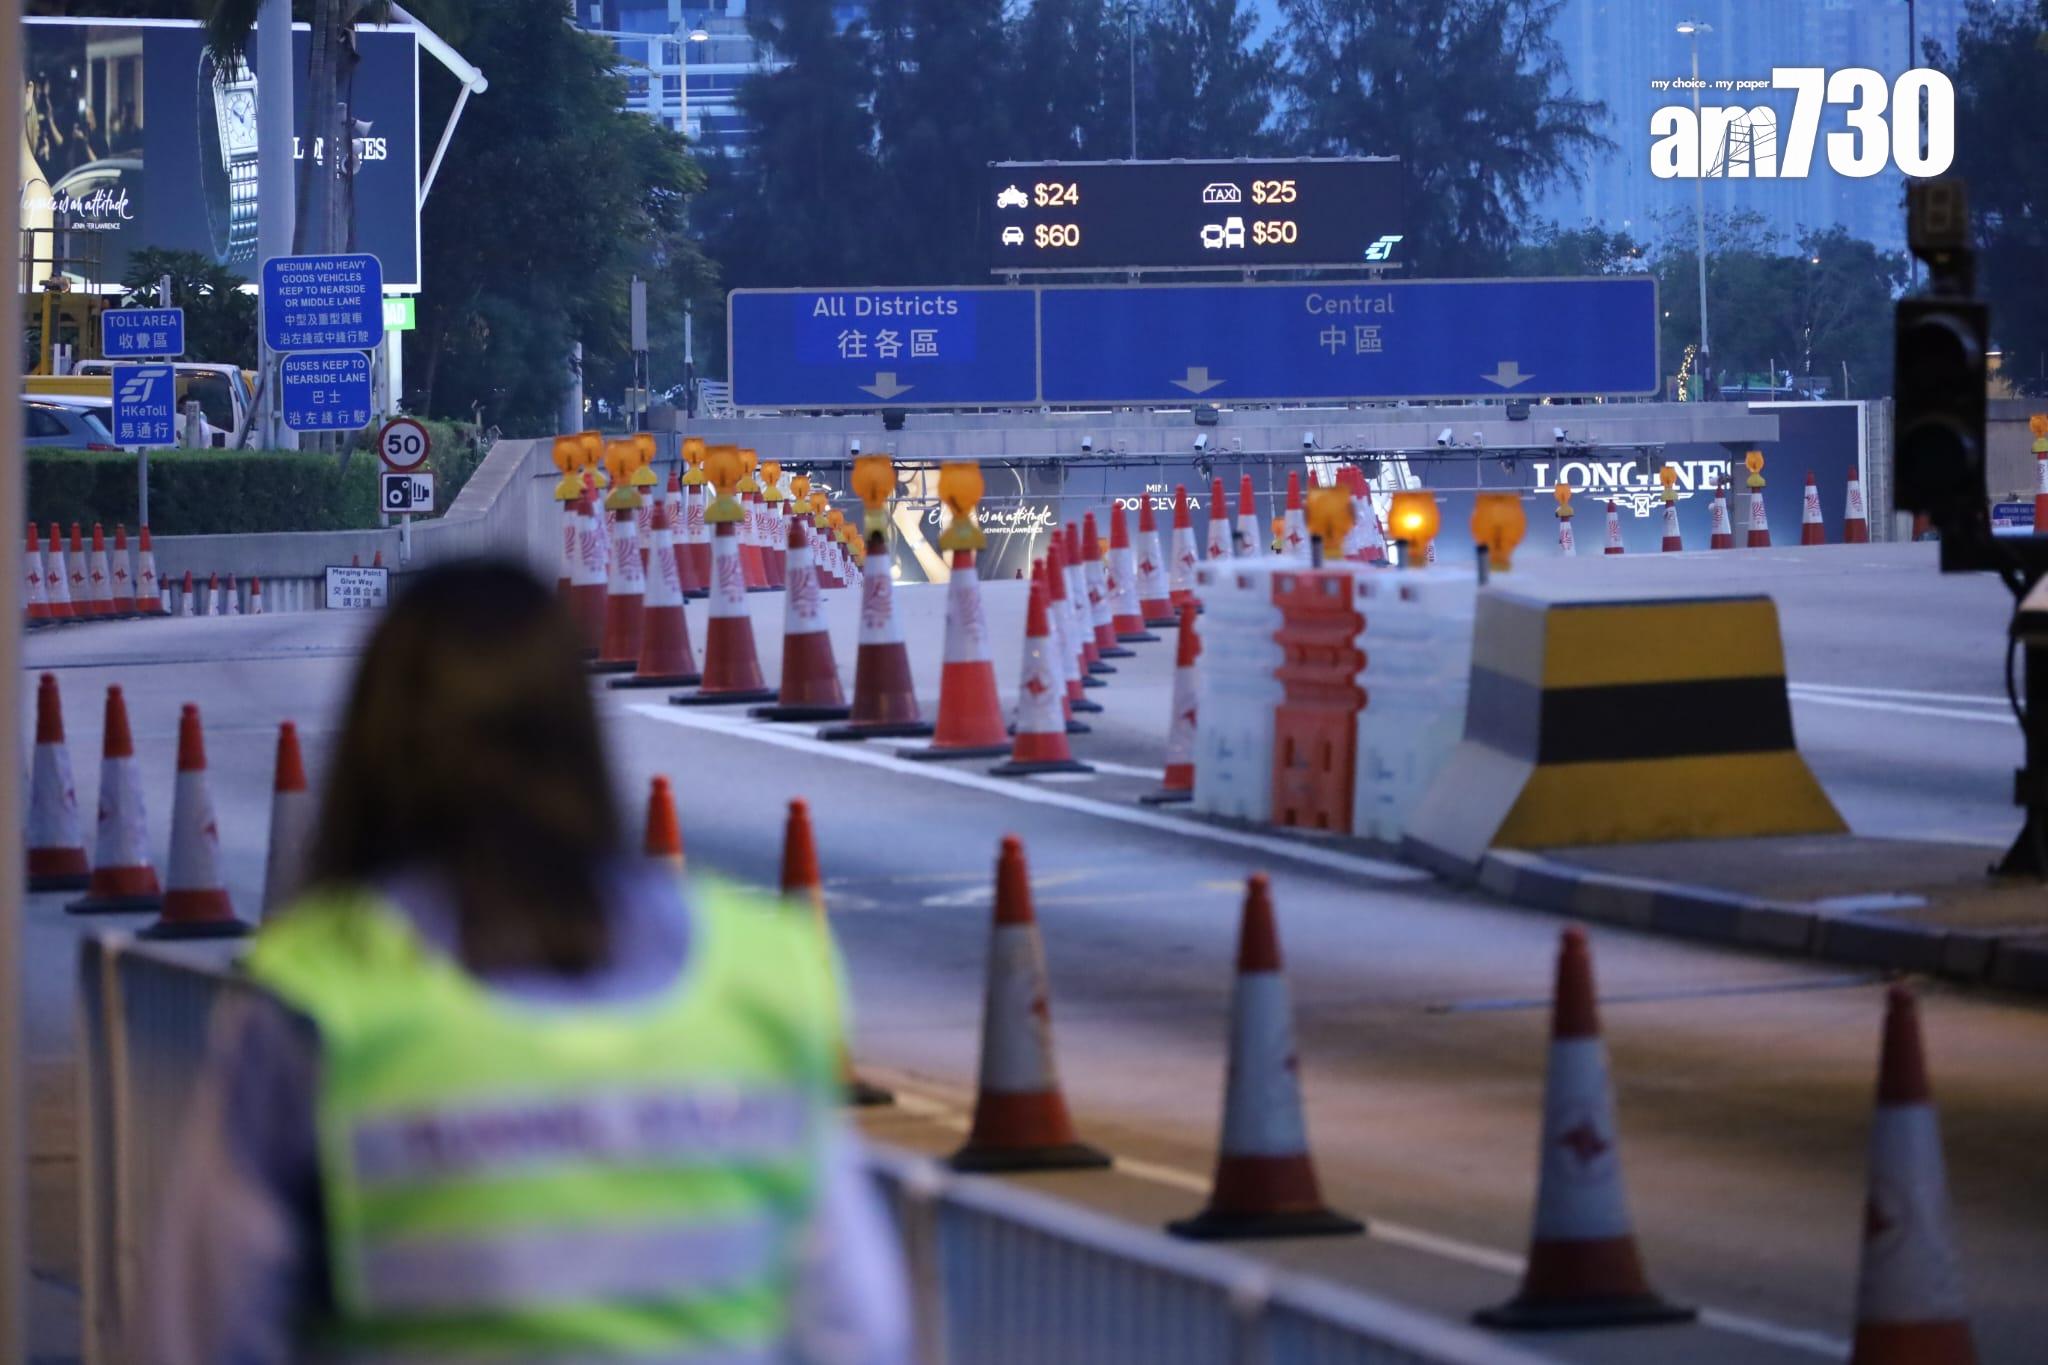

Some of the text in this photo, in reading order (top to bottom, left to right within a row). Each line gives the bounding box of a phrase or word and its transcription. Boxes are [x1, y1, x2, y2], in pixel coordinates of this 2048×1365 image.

[1034, 183, 1079, 207] $24
[1207, 180, 1297, 204] TAXI $25
[85, 187, 134, 220] attitude
[1034, 224, 1080, 248] $60
[1252, 221, 1297, 245] $50
[277, 260, 367, 272] MEDIUM AND HEAVY
[282, 273, 362, 284] GOODS VEHICLES
[279, 284, 366, 296] KEEP TO NEARSIDE
[285, 297, 361, 308] OR MIDDLE LANE
[812, 295, 959, 317] All Districts
[1305, 292, 1395, 314] Central
[109, 315, 177, 327] TOLL AREA
[119, 332, 168, 349] 收費區
[837, 329, 939, 359] 往各區
[1319, 324, 1383, 355] 中區
[286, 359, 365, 371] BUSES KEEP TO
[286, 373, 366, 384] NEARSIDE LANE
[312, 389, 341, 404] 巴士
[121, 405, 167, 417] HKeToll
[121, 422, 168, 439] 易通行
[388, 434, 420, 455] 50
[1006, 504, 1058, 526] attitude
[332, 568, 382, 577] Merging Point
[358, 578, 373, 586] Way
